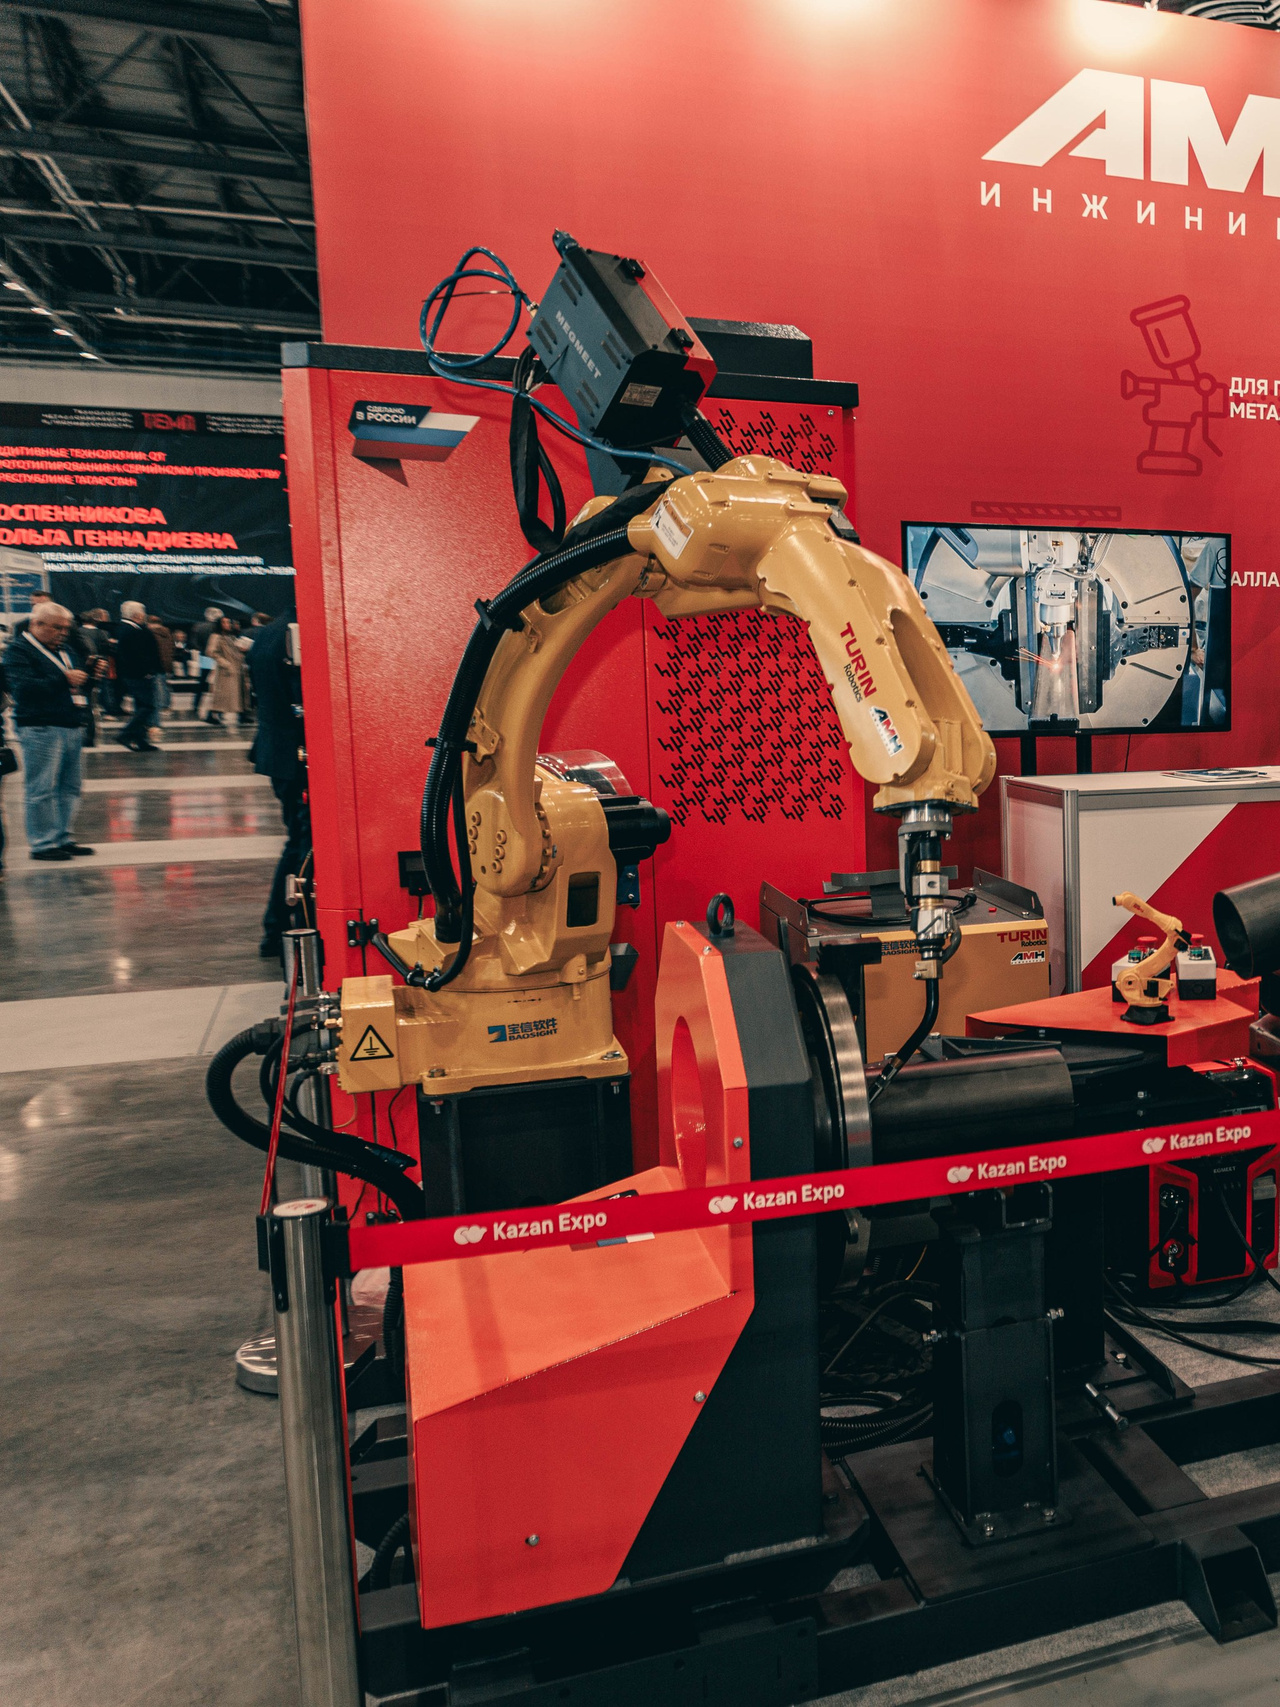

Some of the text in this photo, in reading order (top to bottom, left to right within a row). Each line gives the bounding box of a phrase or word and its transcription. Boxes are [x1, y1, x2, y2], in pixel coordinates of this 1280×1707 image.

[555, 310, 602, 379] MEGMEET
[1229, 377, 1269, 397] ДЛЯ
[355, 411, 416, 424] В РОССИИ
[366, 404, 406, 415] СДЕЛАНО
[73, 529, 239, 551] ГЕННАДИЕВНА
[1230, 571, 1280, 588] АЛЛА
[840, 622, 877, 698] TURIN
[843, 663, 863, 703] Robotics
[997, 929, 1047, 943] TURIN
[508, 1017, 557, 1035] 宝信软件
[509, 1028, 558, 1041] BAOSIGHT
[1170, 1126, 1252, 1150] Kazan Expo
[977, 1154, 1067, 1180] Kazan Expo
[743, 1183, 845, 1211] Kazan Expo
[493, 1212, 607, 1241] Kazan Expo
